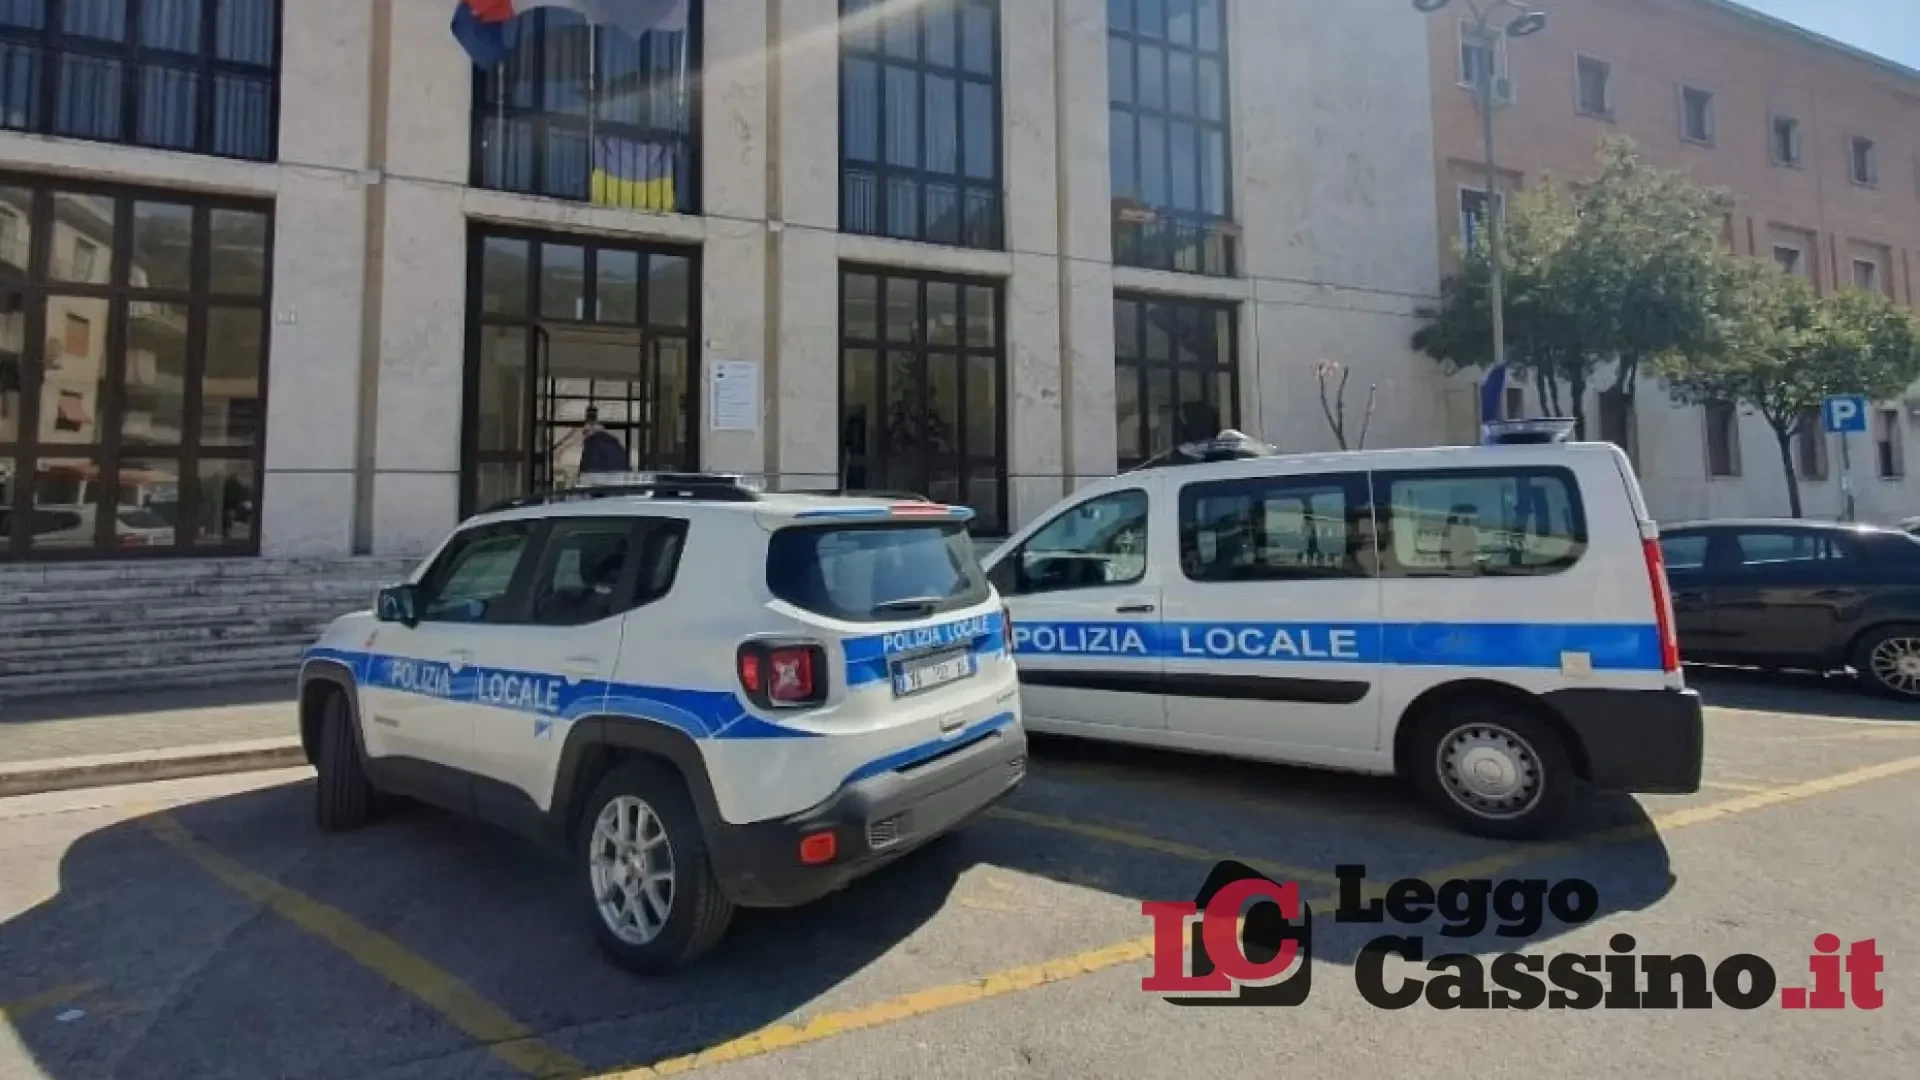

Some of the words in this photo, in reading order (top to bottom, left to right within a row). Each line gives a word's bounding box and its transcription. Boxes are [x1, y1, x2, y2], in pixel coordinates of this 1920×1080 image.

[1831, 399, 1857, 429] P
[884, 627, 941, 652] POLIZIA
[949, 614, 990, 639] LOCALE
[1013, 626, 1147, 653] POLIZIA
[1180, 627, 1359, 658] LOCALE
[391, 660, 450, 695] POLIZIA
[477, 671, 561, 712] LOCALE
